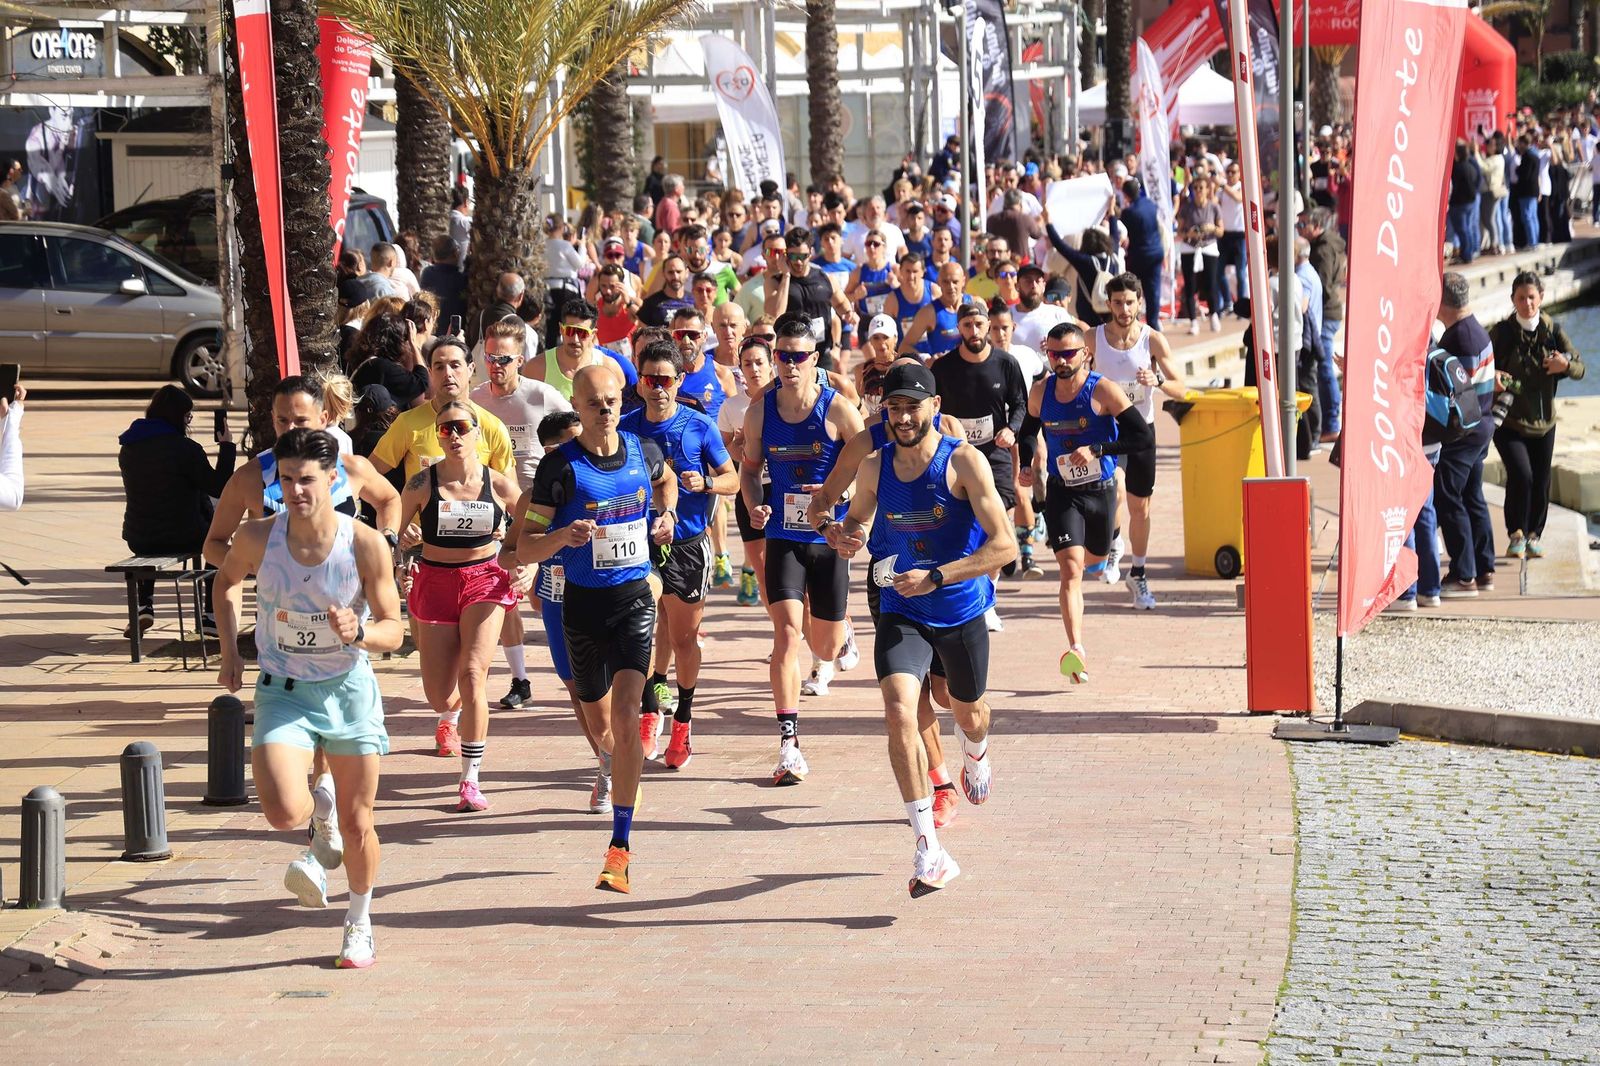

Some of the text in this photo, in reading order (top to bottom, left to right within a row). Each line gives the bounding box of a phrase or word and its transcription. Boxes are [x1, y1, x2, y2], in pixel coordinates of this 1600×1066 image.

[31, 27, 97, 59] one4one
[1376, 25, 1423, 266] Deporte
[1370, 294, 1406, 478] Somos
[965, 430, 983, 440] 242
[1069, 465, 1089, 478] 139
[470, 502, 489, 510] RUN
[456, 517, 474, 530] 22
[627, 521, 644, 531] RUN
[611, 540, 636, 558] 110
[310, 613, 330, 622] RU
[296, 631, 317, 647] 32
